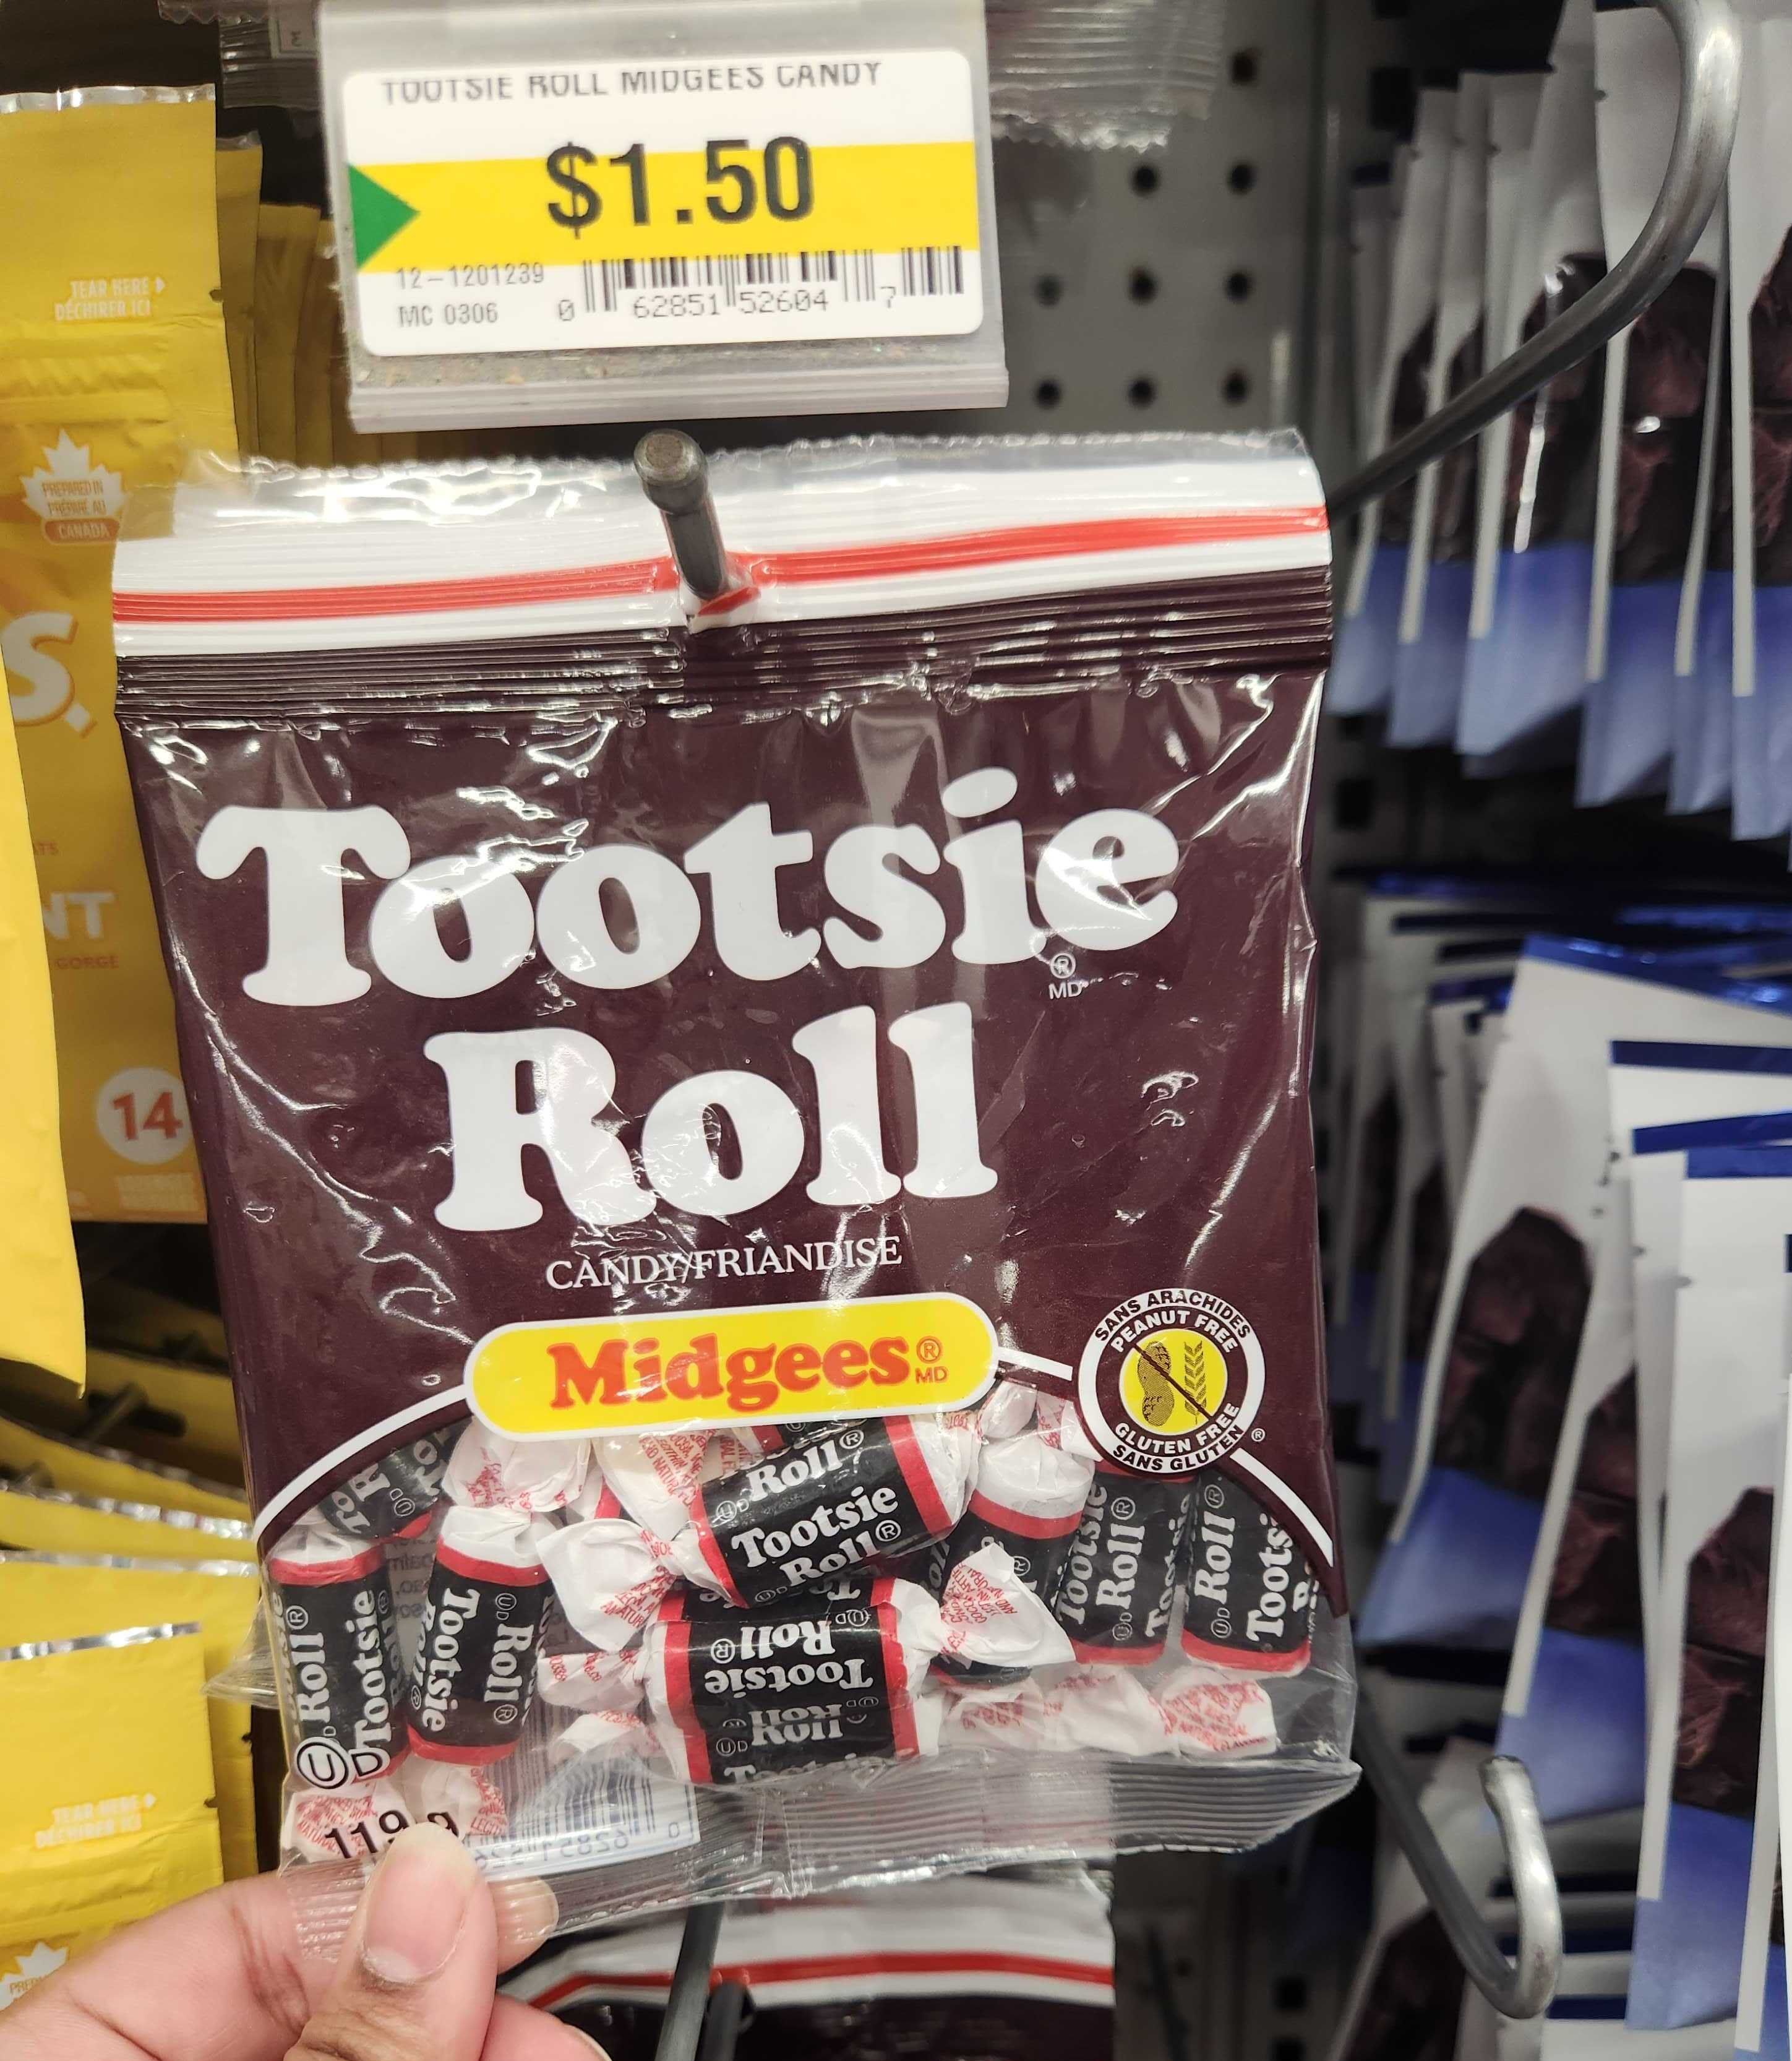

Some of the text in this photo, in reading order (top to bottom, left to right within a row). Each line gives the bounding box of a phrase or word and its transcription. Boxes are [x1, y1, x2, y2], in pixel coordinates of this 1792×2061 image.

[381, 62, 882, 105] TOOTSIE ROLL MIDGEES CANDY
[547, 136, 815, 238] $1.50
[69, 277, 149, 298] TEAR HERE
[396, 262, 545, 290] 12-1201239
[397, 303, 498, 327] MC 0306
[633, 294, 720, 318] 62851
[740, 288, 829, 314] 52604
[58, 522, 111, 540] CANADA
[195, 767, 1182, 1006] Tootsie
[1048, 981, 1084, 1000] MD
[112, 1091, 184, 1142] 14
[423, 1000, 1000, 1233] Roll
[1094, 1289, 1251, 1342] SANS ARACHIDES
[1110, 1309, 1238, 1354] PEANUT FREE
[546, 1332, 910, 1414] Midgees
[915, 1366, 948, 1385] MD
[1113, 1425, 1245, 1471] SANS GLUTEN
[1114, 1402, 1240, 1455] GLUTEN FREE
[731, 1485, 899, 1568] Tootsie
[345, 1589, 392, 1751] Tootsie
[421, 1587, 481, 1732] Tootsie
[704, 1658, 874, 1699] Tootsie
